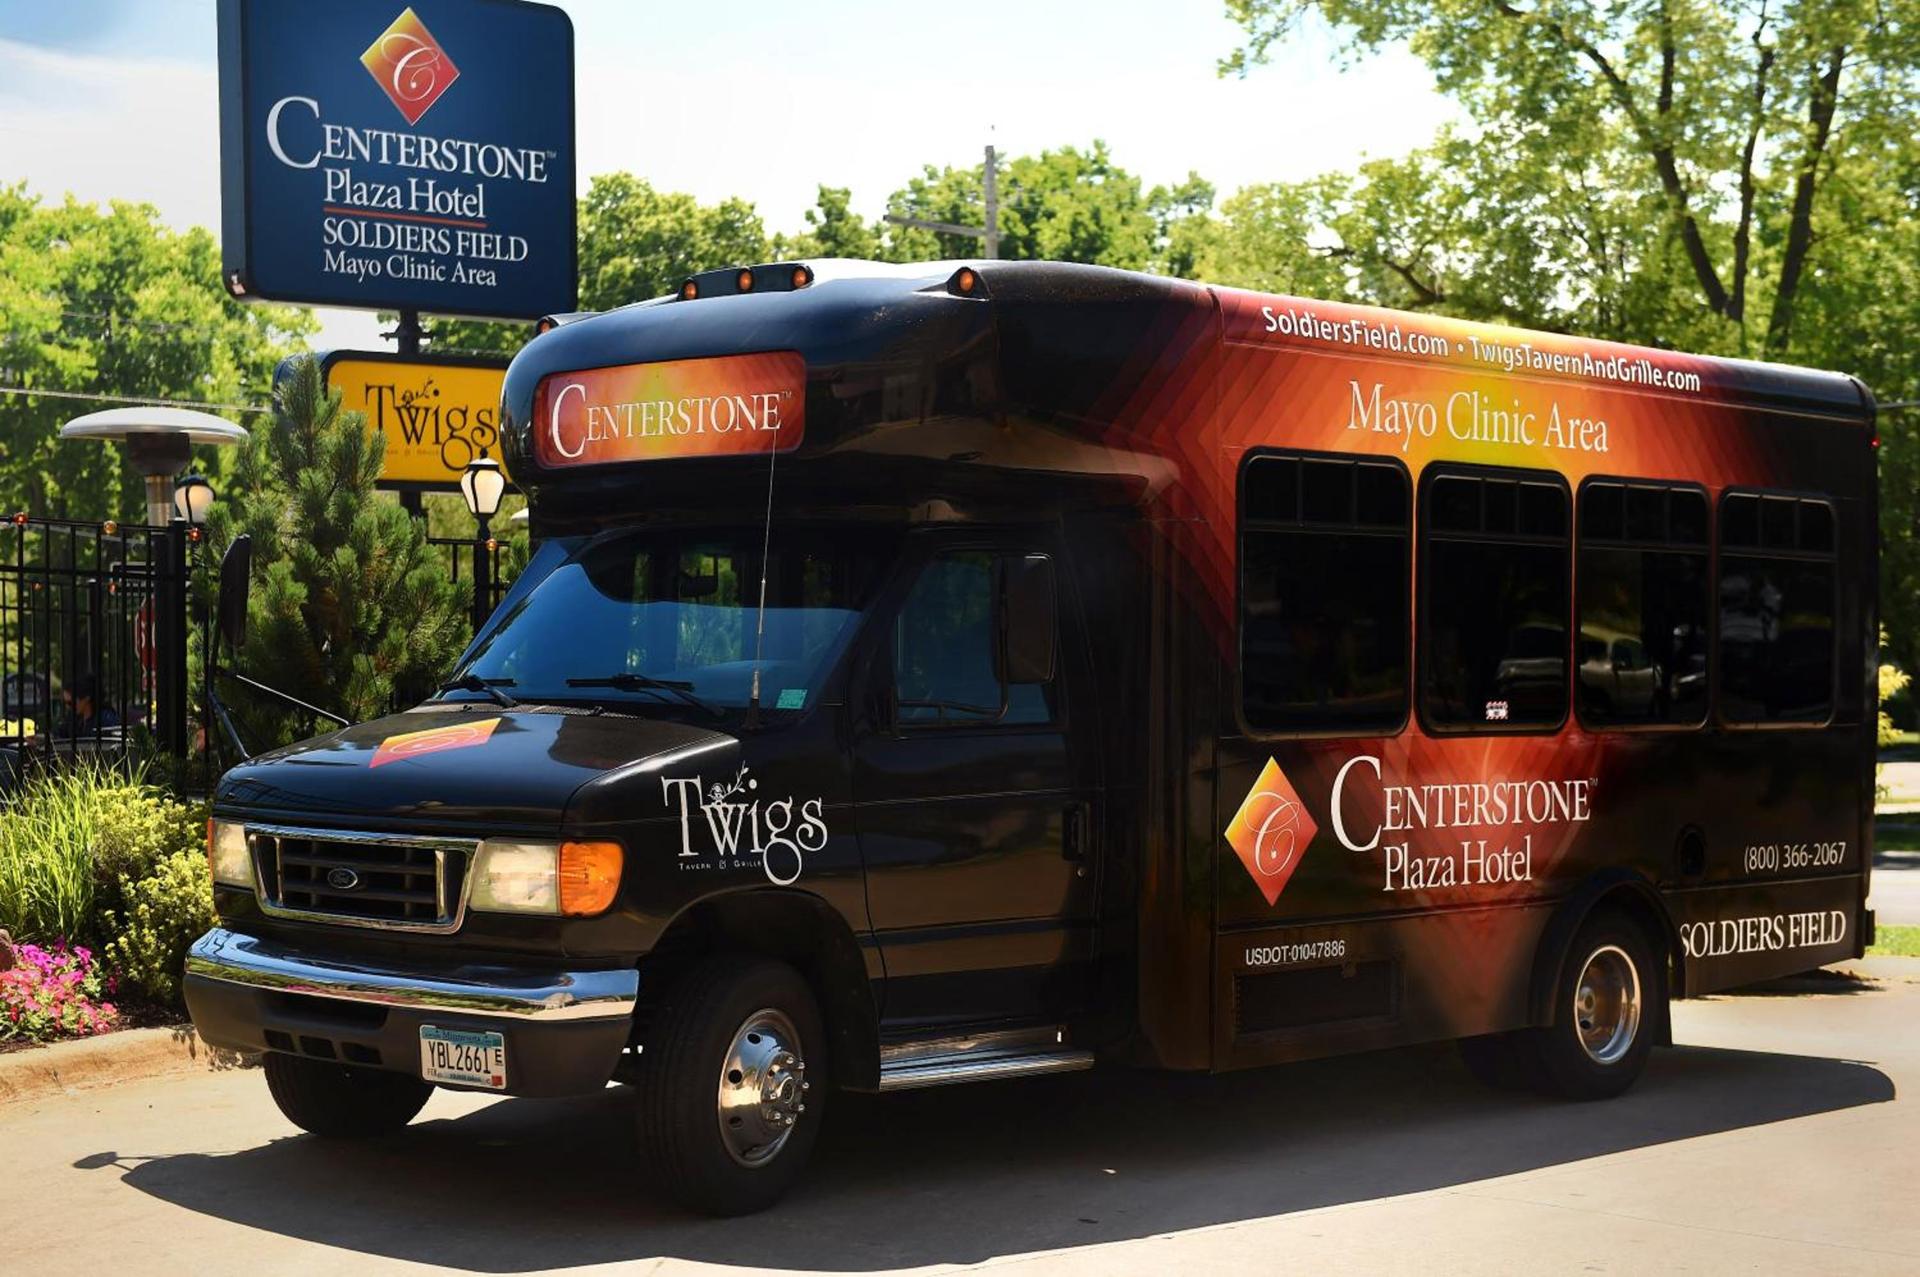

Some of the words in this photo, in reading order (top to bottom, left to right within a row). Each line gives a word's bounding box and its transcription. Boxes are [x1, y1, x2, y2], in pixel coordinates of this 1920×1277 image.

[324, 168, 401, 209] Plaza
[408, 178, 486, 218] Hotel
[323, 217, 450, 255] SOLDIERS
[457, 231, 528, 262] FIELD
[324, 249, 381, 283] Mayo
[386, 259, 446, 281] Clinic
[451, 263, 497, 286] Area
[1262, 307, 1448, 356] SoldiersField.com
[1468, 336, 1701, 392] TwigsTavernAndGrille.com
[365, 382, 497, 471] Twigs
[1347, 381, 1437, 451] Mayo
[1446, 391, 1535, 445] Clinic
[1543, 402, 1609, 452] Area
[661, 774, 828, 886] Twigs
[1383, 842, 1456, 891] Plaza
[1461, 836, 1532, 885] Hotel
[1744, 844, 1779, 873] (800)
[1783, 842, 1847, 868] 366-2067
[1680, 915, 1785, 958] SOLDIERS
[1788, 910, 1847, 948] FIELD
[428, 1040, 491, 1075] YBL2661
